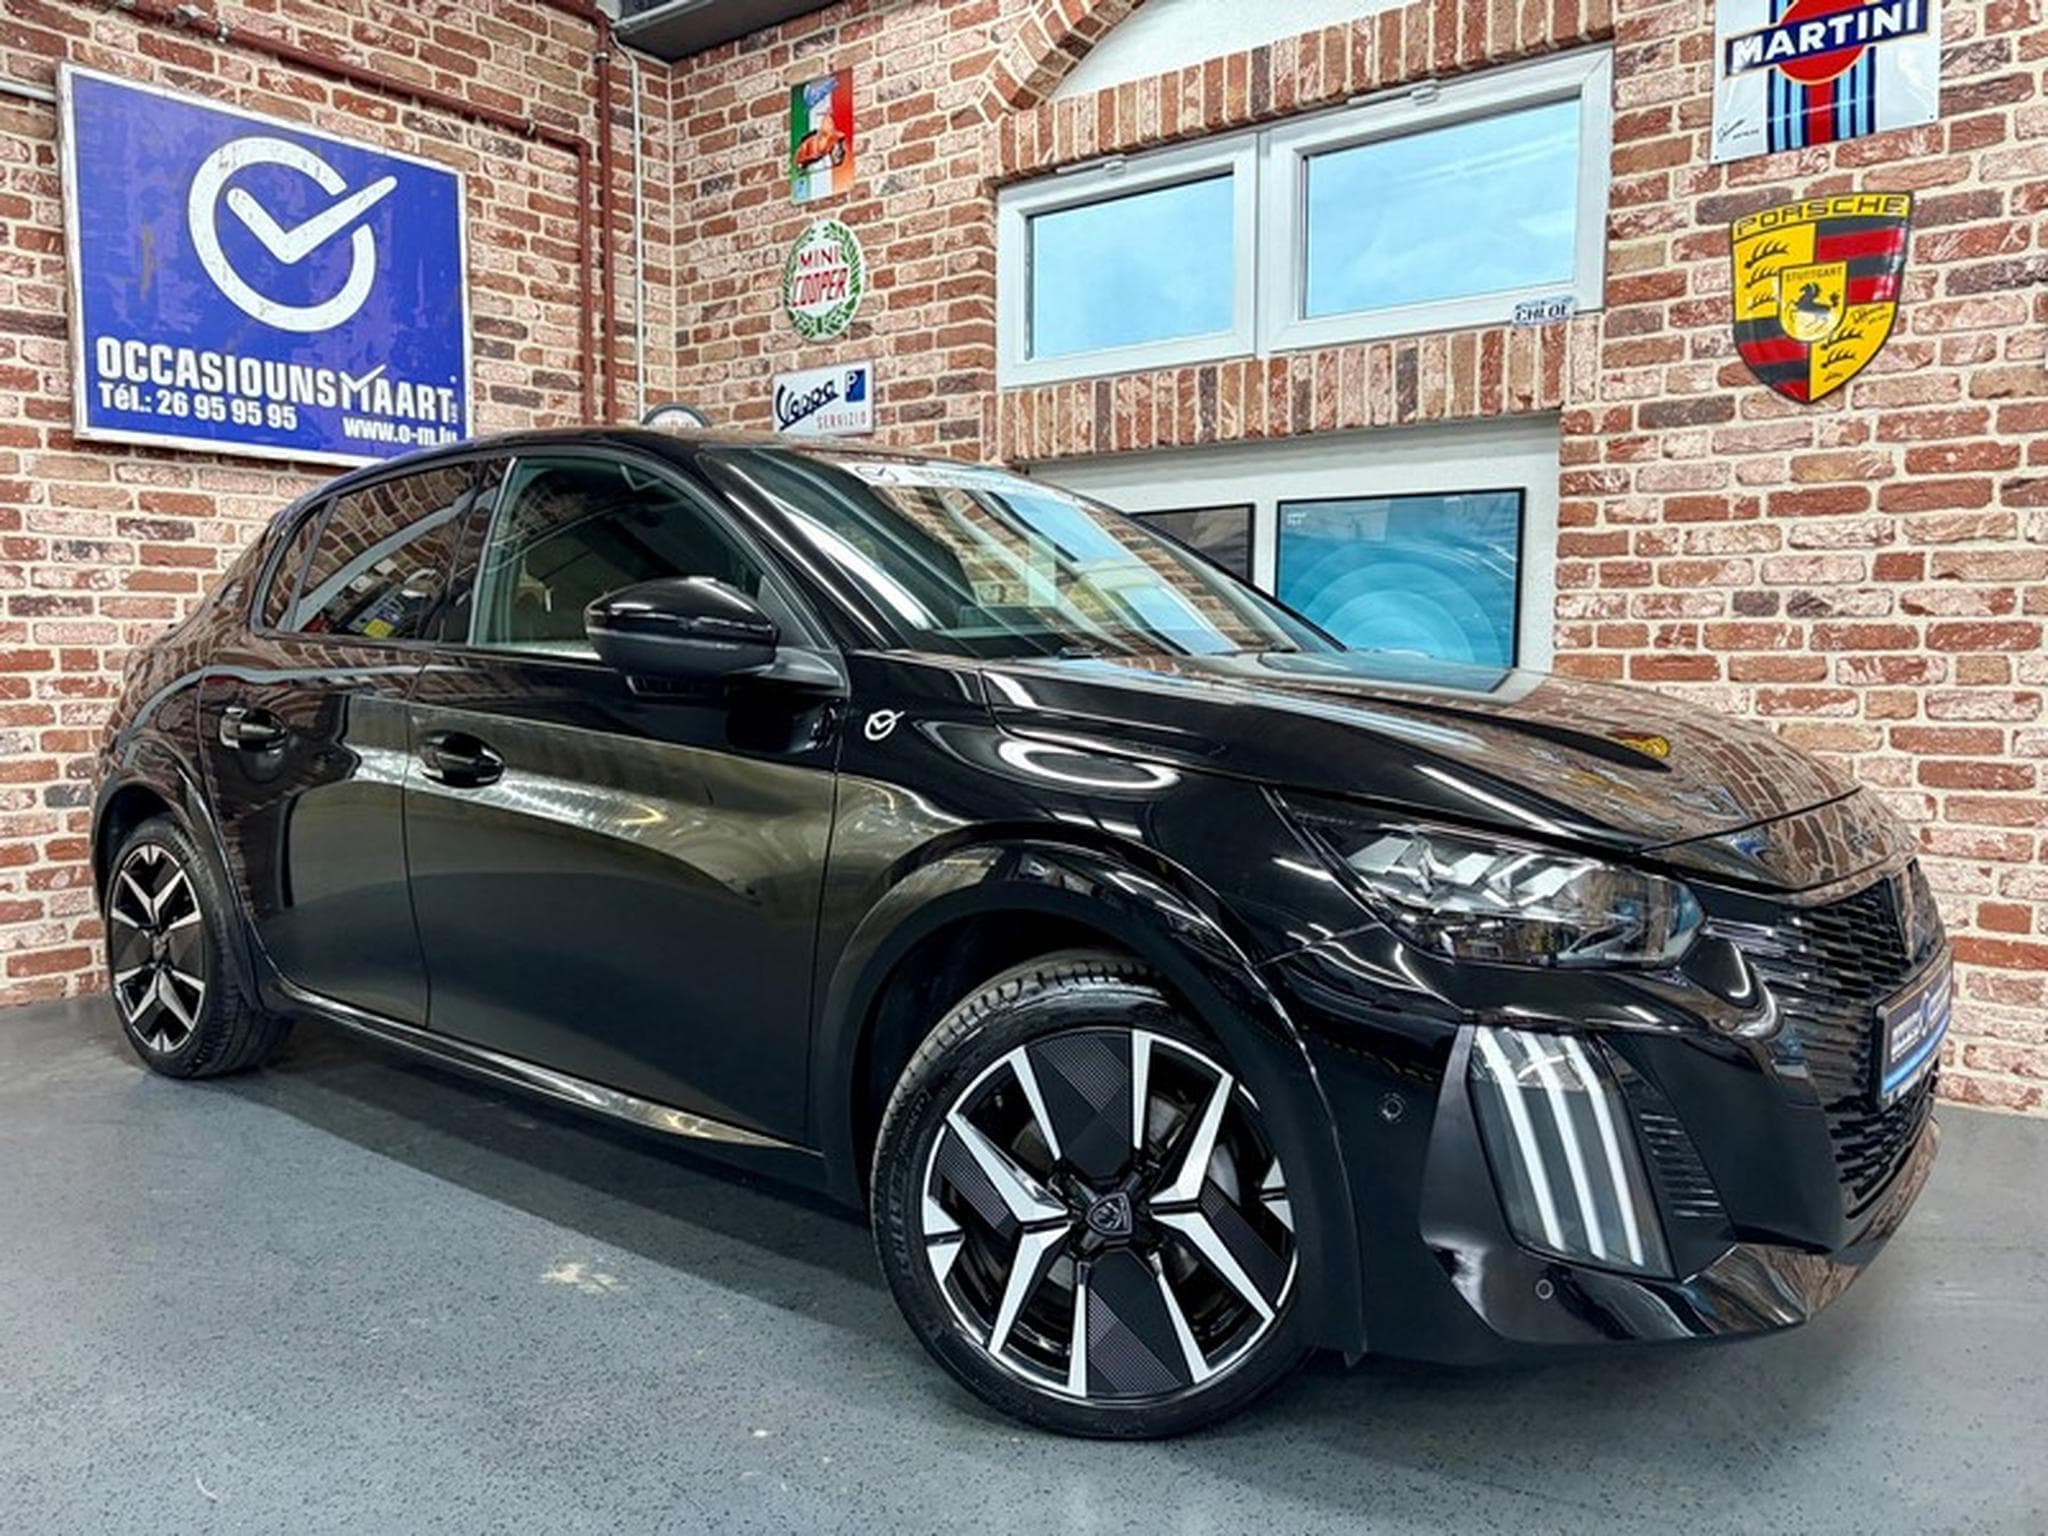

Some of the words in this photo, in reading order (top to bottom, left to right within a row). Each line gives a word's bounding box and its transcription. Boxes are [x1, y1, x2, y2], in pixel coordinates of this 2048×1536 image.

[1732, 0, 1918, 73] MARTINI
[1737, 196, 1905, 236] PORSCHE
[800, 245, 839, 267] MINI
[791, 268, 848, 307] COOPER
[98, 381, 152, 413] Tél.:
[156, 389, 189, 418] 26
[194, 393, 226, 422] 95
[231, 398, 263, 427] 95
[266, 402, 298, 431] 95
[776, 380, 839, 431] Vespa
[817, 411, 867, 429] SERVIZIO
